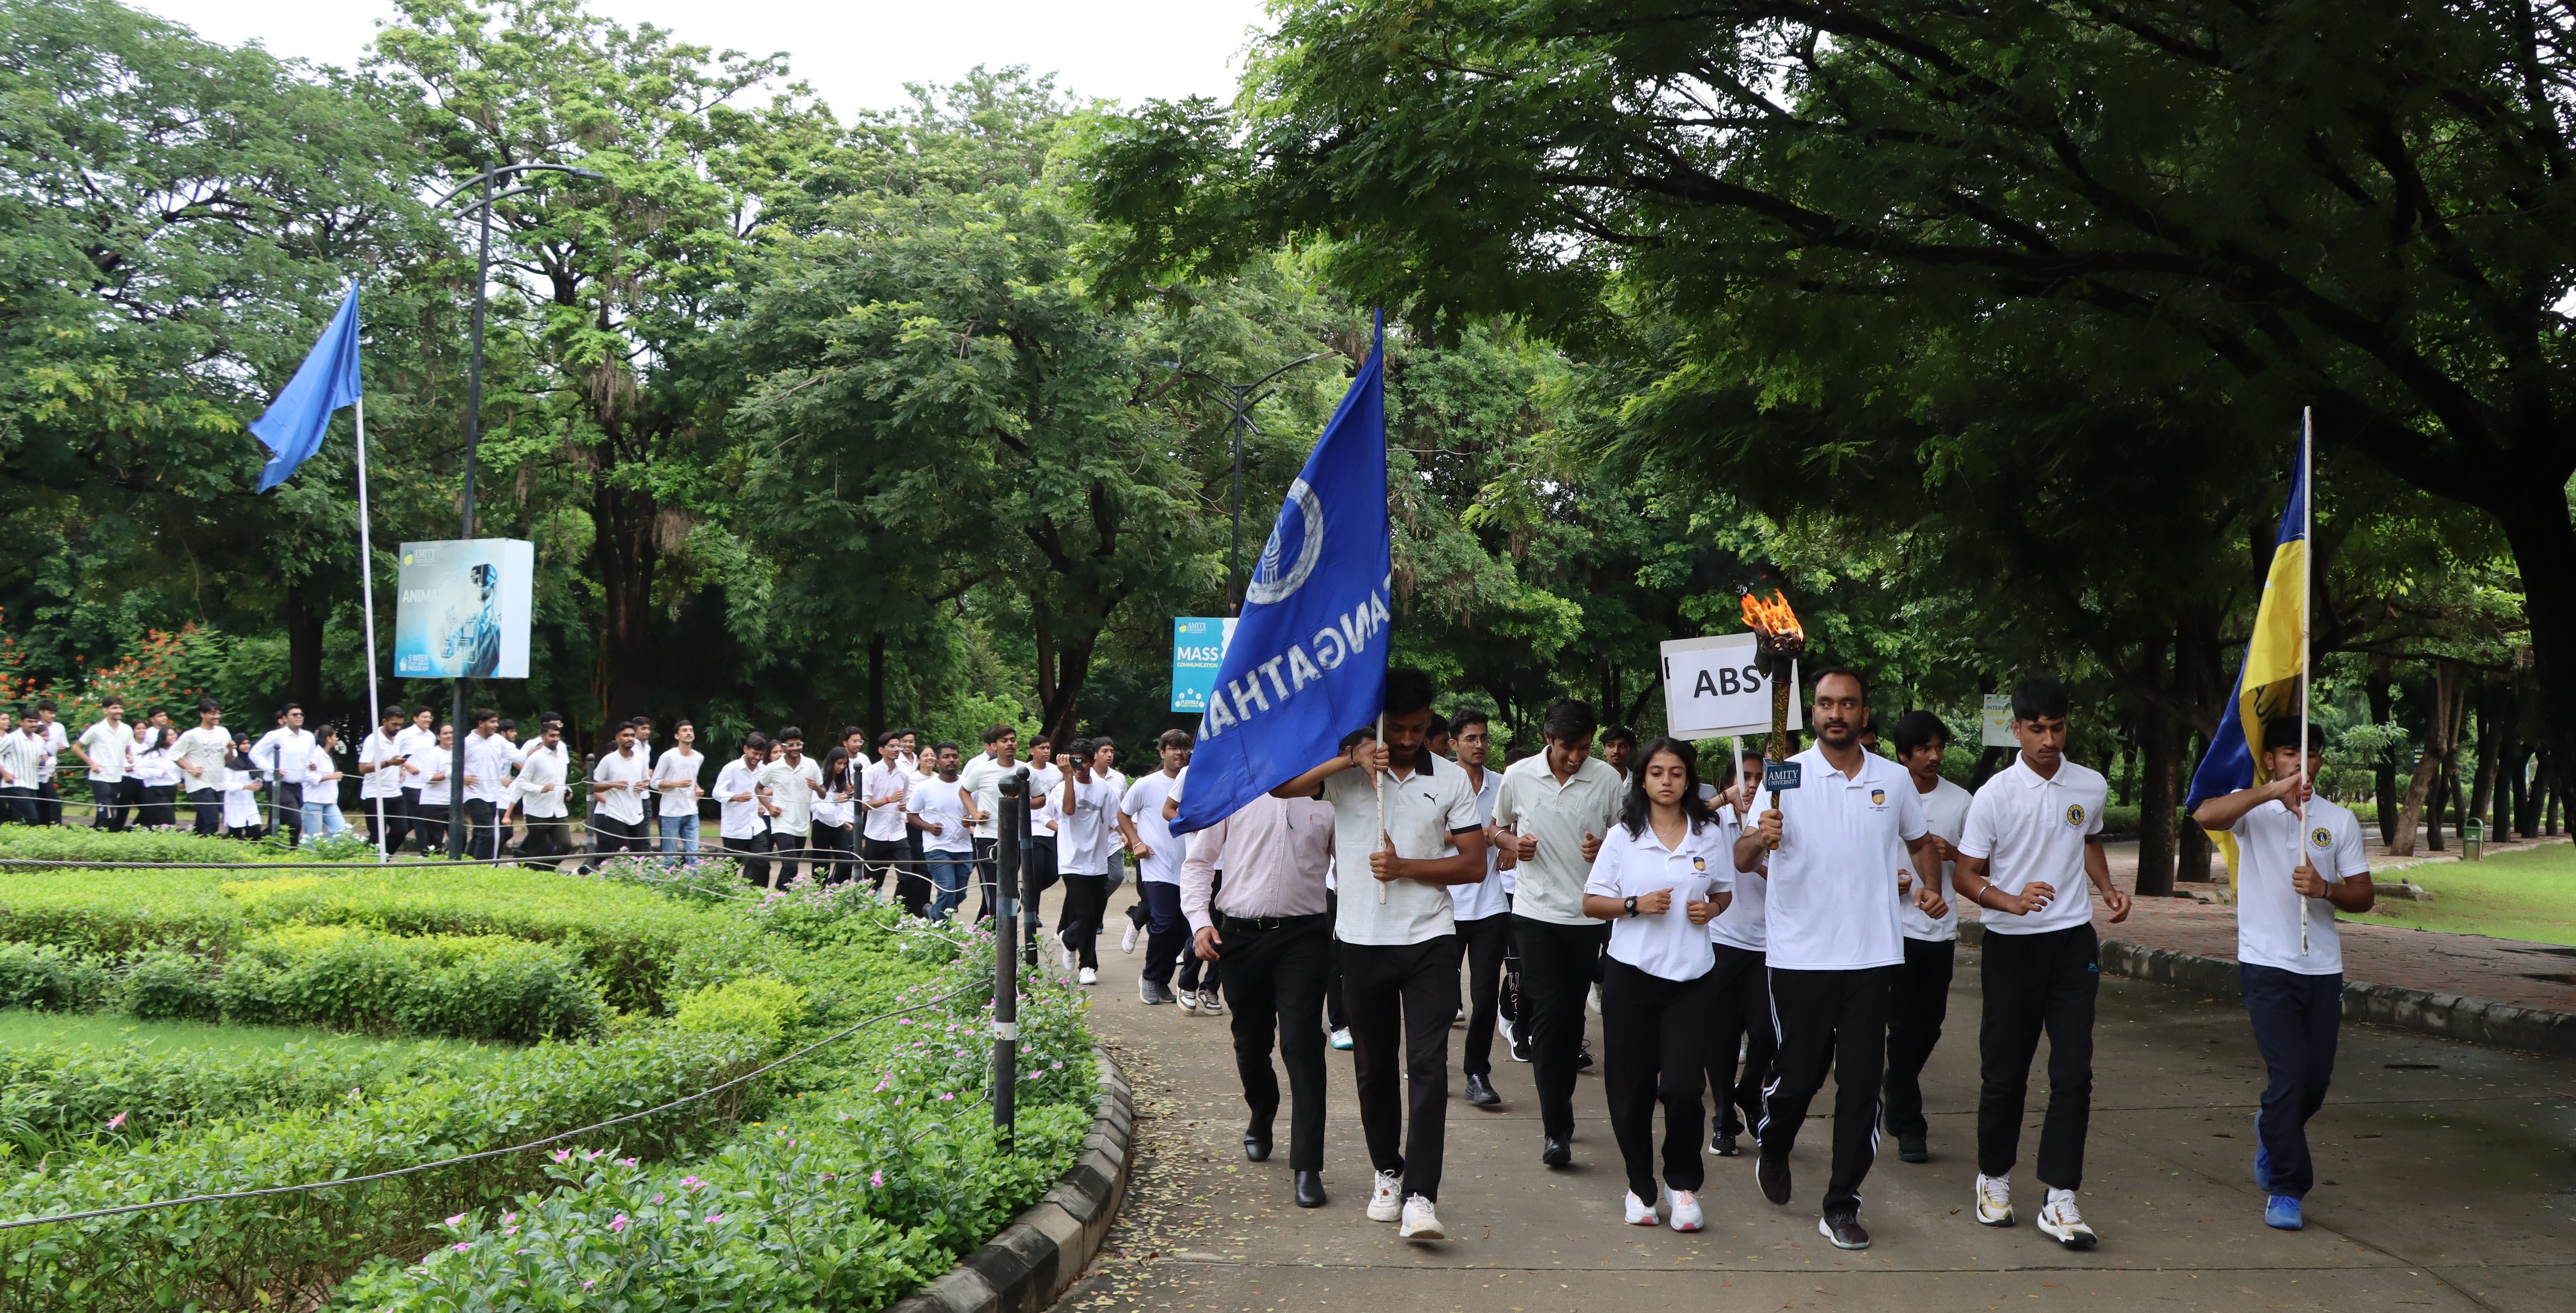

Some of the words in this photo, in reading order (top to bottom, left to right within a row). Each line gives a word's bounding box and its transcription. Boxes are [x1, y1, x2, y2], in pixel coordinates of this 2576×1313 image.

[1177, 647, 1218, 661] MASS
[1694, 665, 1761, 698] ABS
[1768, 770, 1799, 780] AMITY
[2064, 819, 2086, 830] SANGATHAN
[2309, 841, 2333, 852] SANGATHAN
